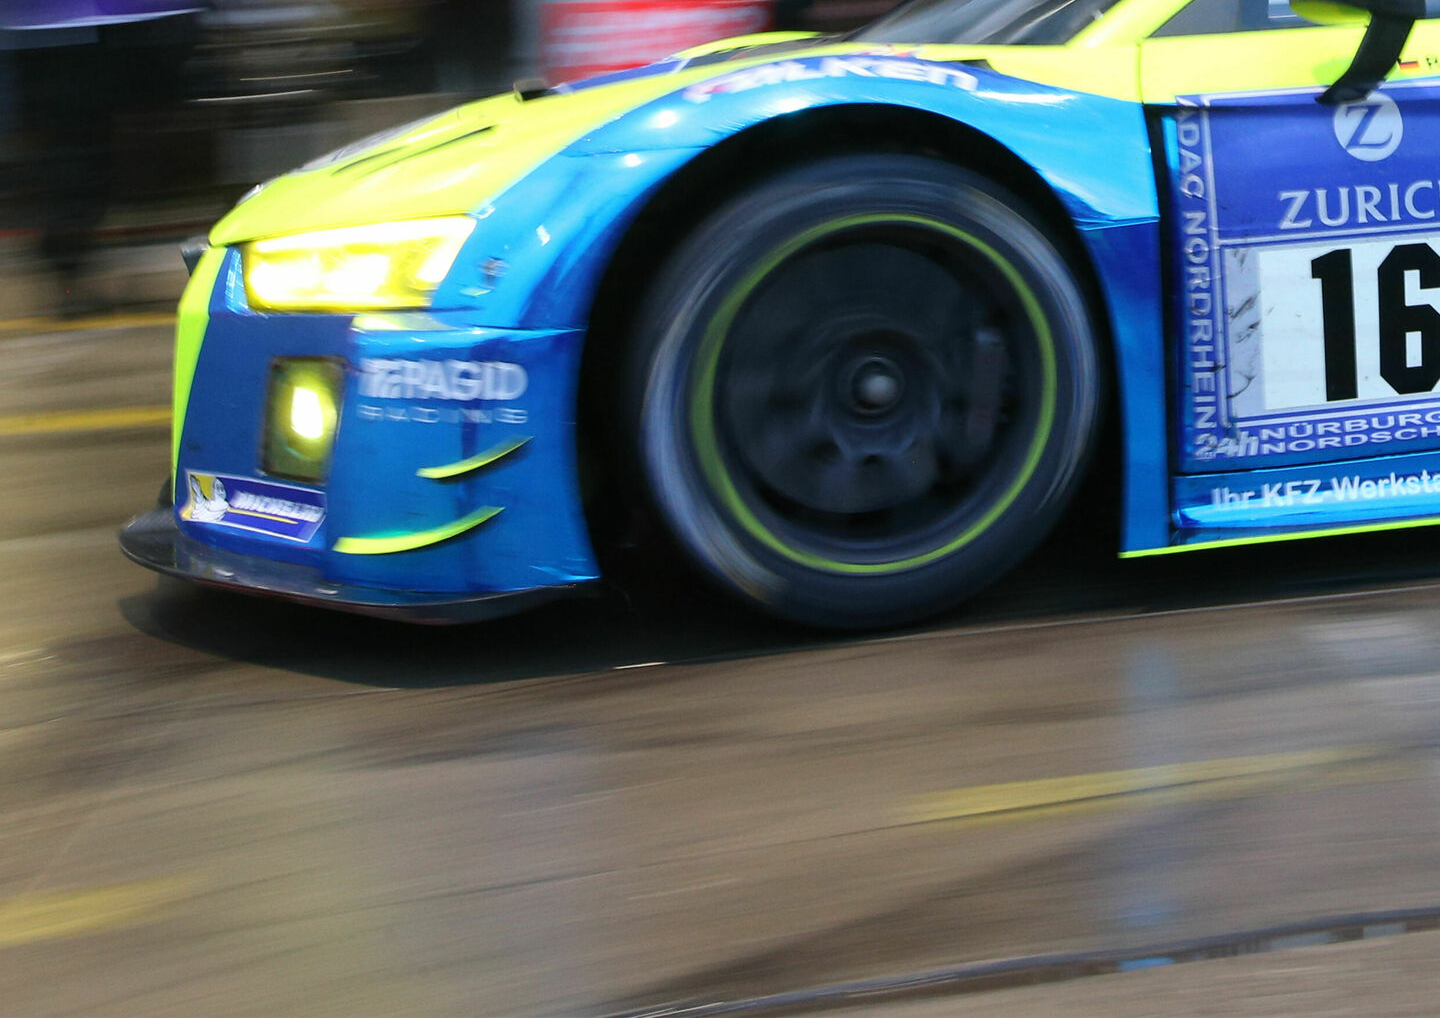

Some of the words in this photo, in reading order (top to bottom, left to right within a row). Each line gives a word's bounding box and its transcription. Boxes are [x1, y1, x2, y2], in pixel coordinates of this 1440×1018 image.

[1184, 210, 1218, 429] NORDRHEIN
[398, 360, 528, 402] PAGID
[1195, 430, 1259, 460] 24h
[1211, 487, 1255, 510] Ihr
